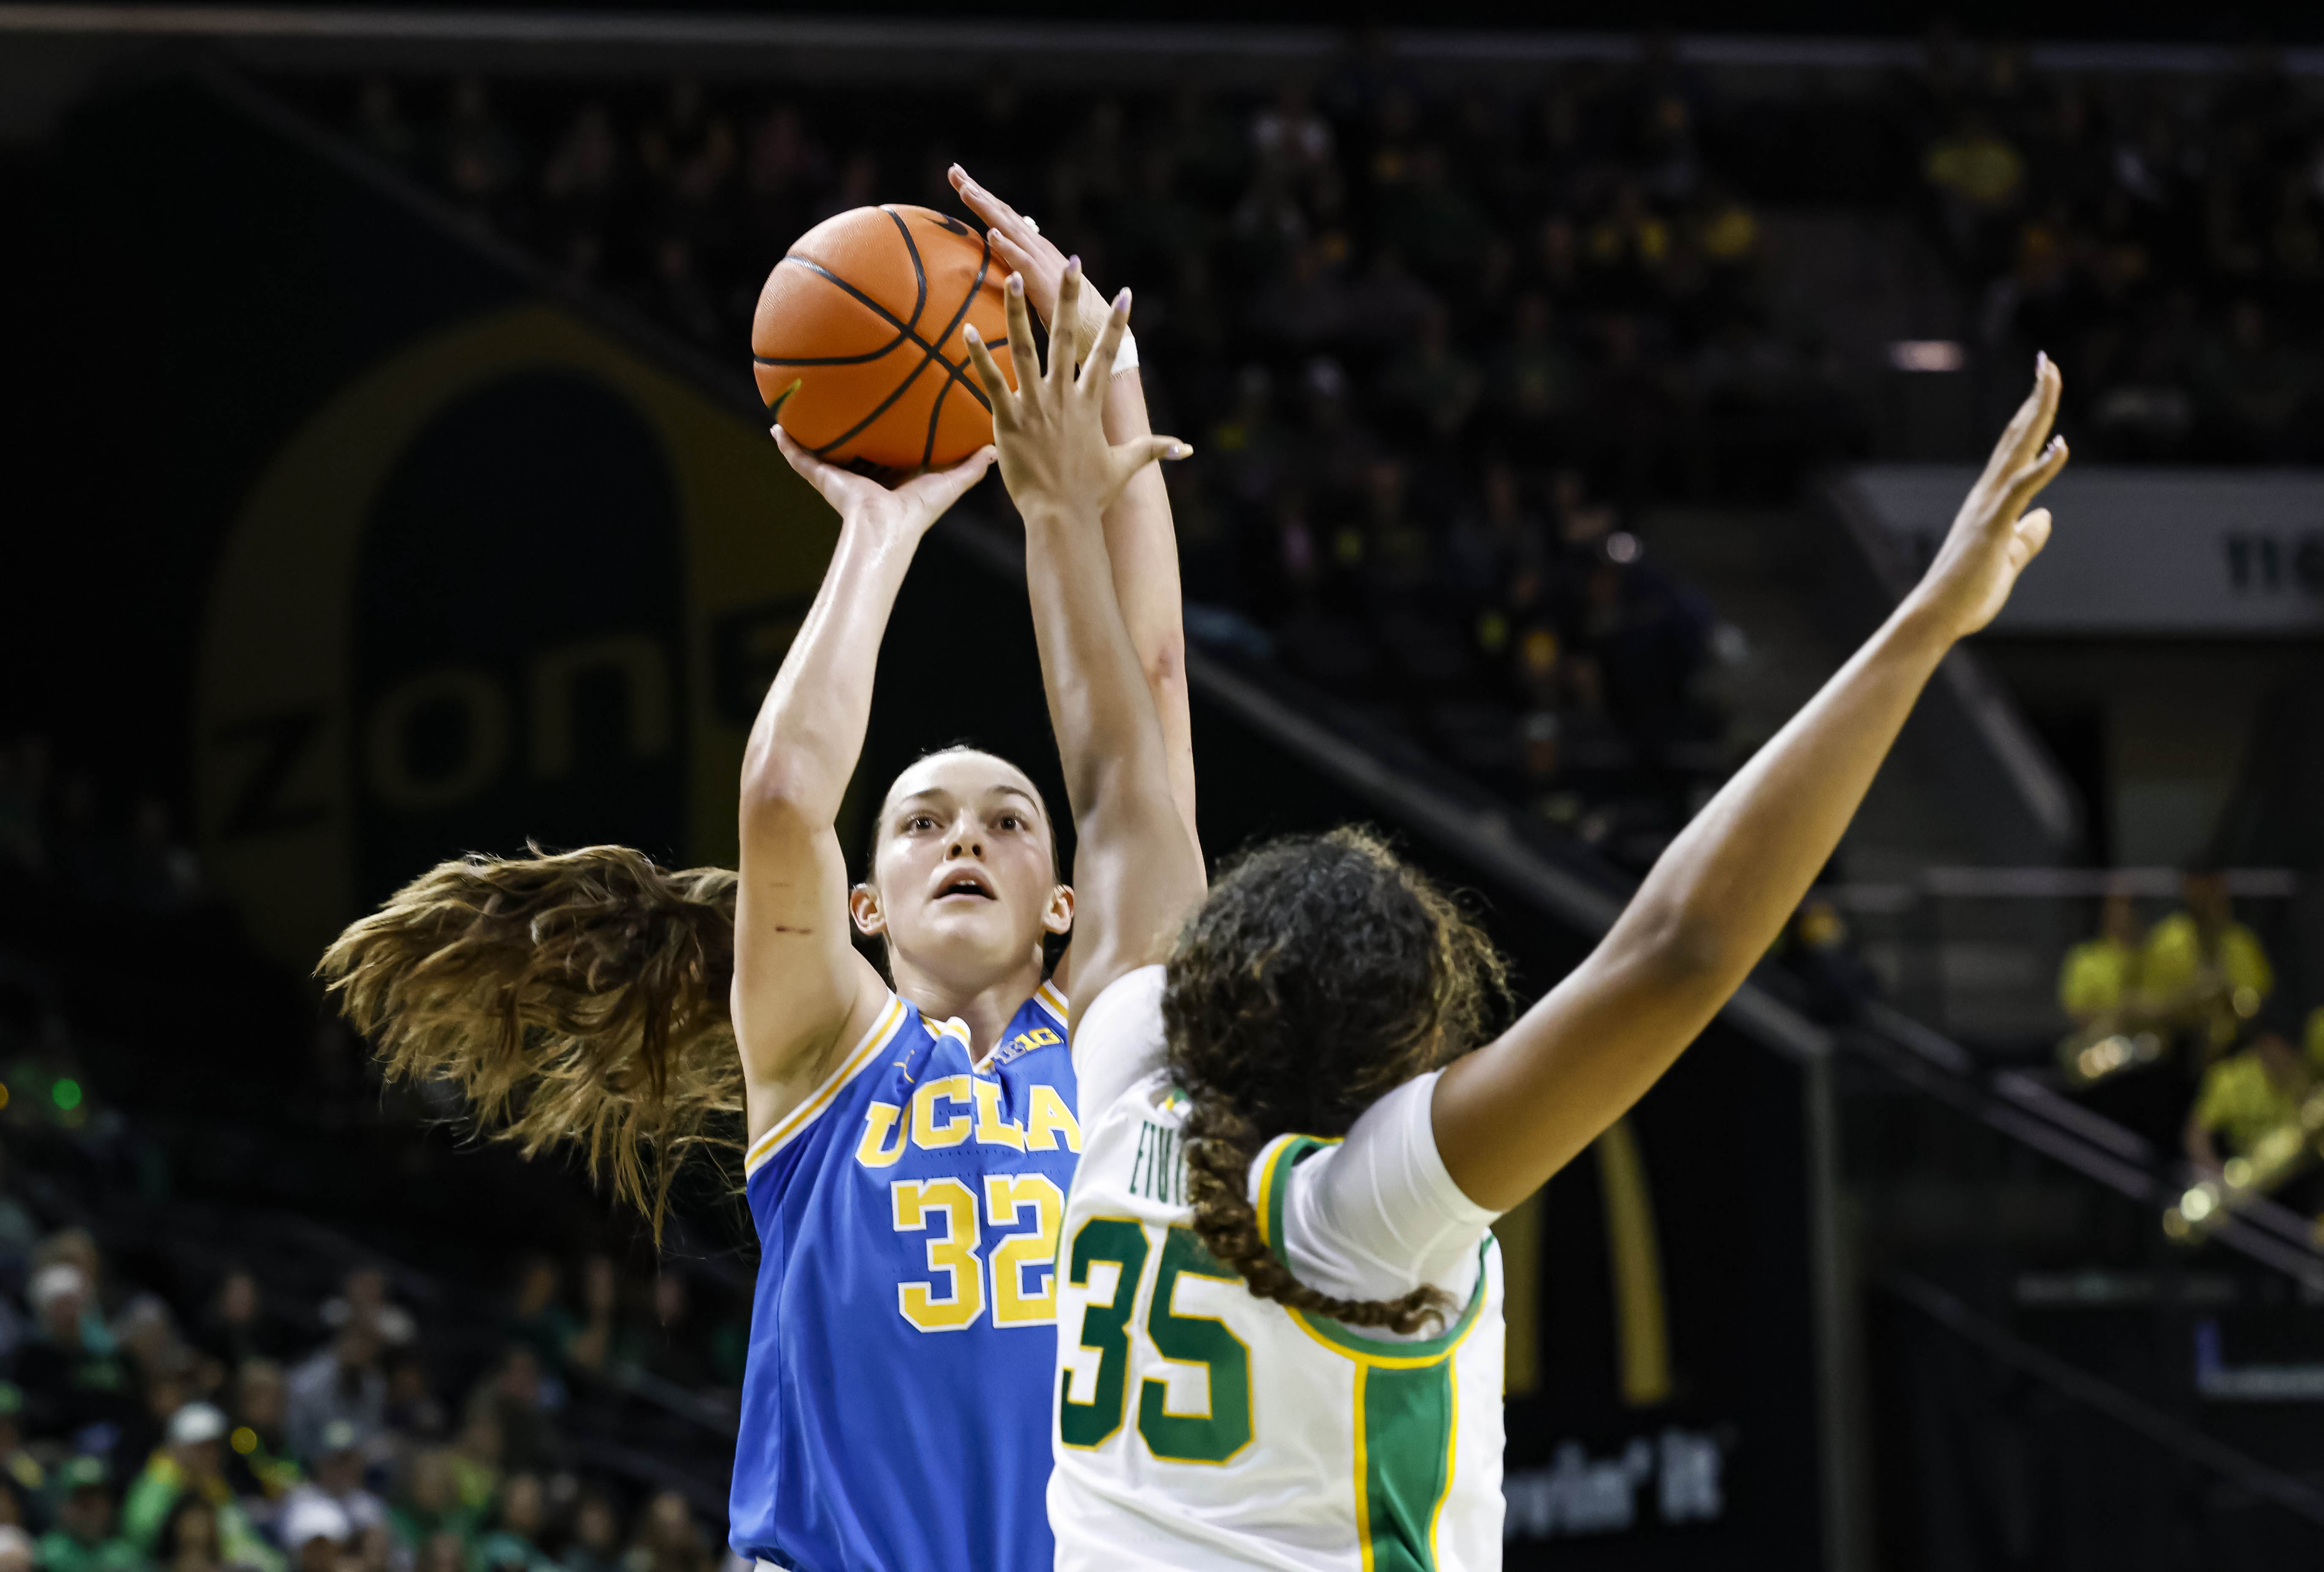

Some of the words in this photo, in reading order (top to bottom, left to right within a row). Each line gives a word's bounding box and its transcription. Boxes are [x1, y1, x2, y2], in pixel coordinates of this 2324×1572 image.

[855, 1074, 1081, 1168] UCLA
[890, 1172, 1066, 1333] 32
[1060, 1215, 1255, 1466] 35
